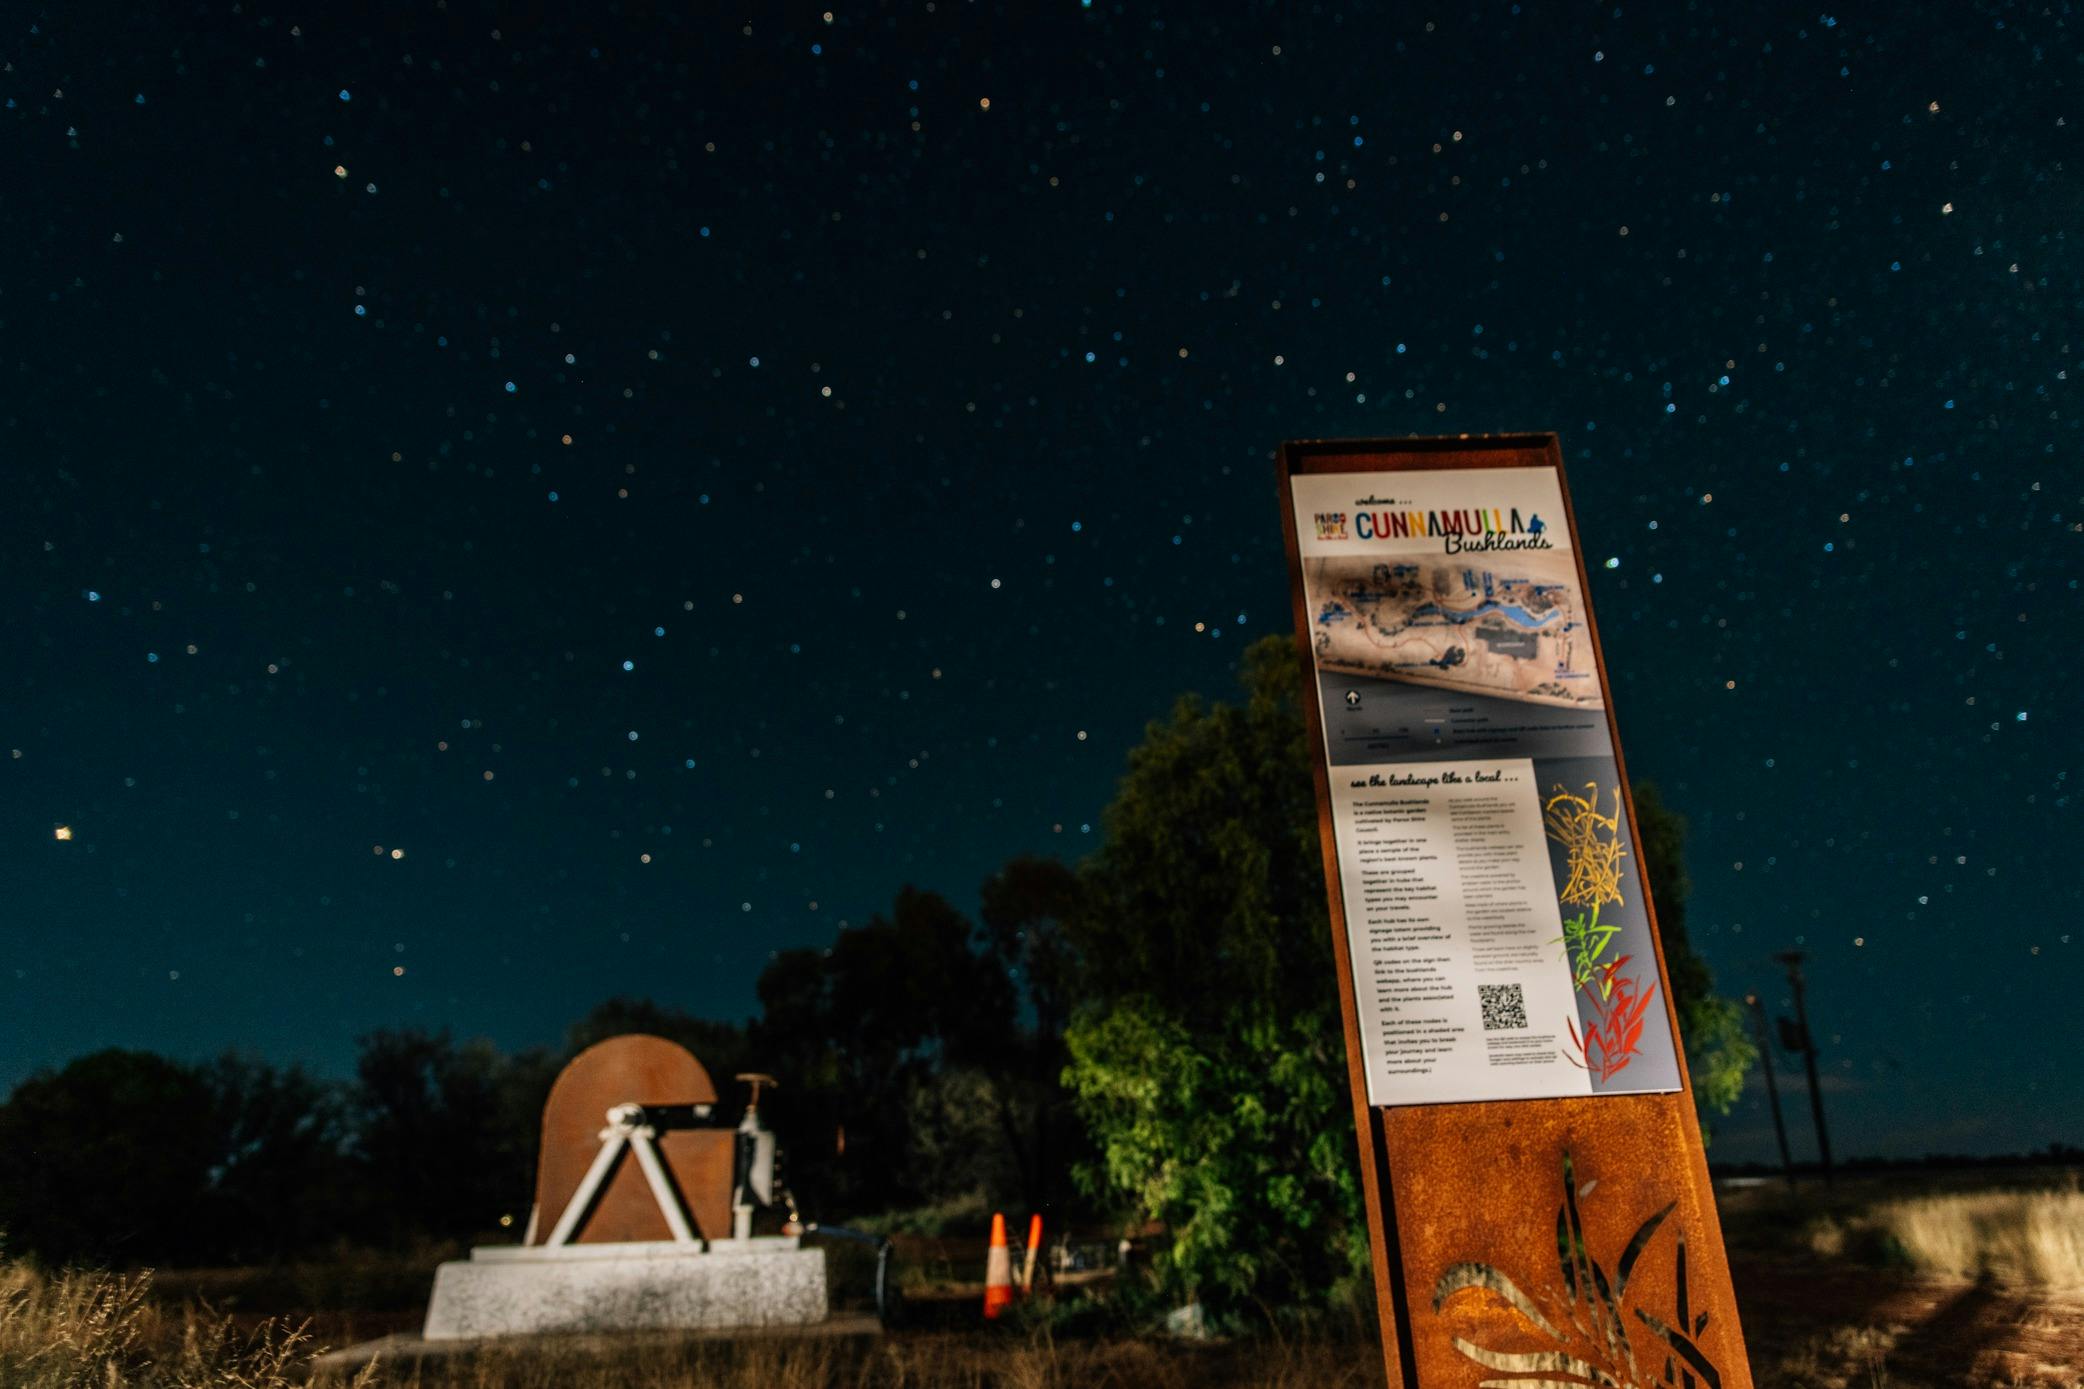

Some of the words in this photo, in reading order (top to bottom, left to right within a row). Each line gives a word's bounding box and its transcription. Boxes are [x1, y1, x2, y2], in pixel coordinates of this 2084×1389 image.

[1314, 512, 1346, 524] PAROO
[1356, 508, 1525, 540] CUNNAMULLA
[1440, 530, 1553, 555] Bushlands
[1351, 780, 1366, 788] see
[1369, 774, 1386, 787] the
[1390, 773, 1439, 788] landscape
[1442, 771, 1462, 784] like
[1475, 769, 1501, 783] local
